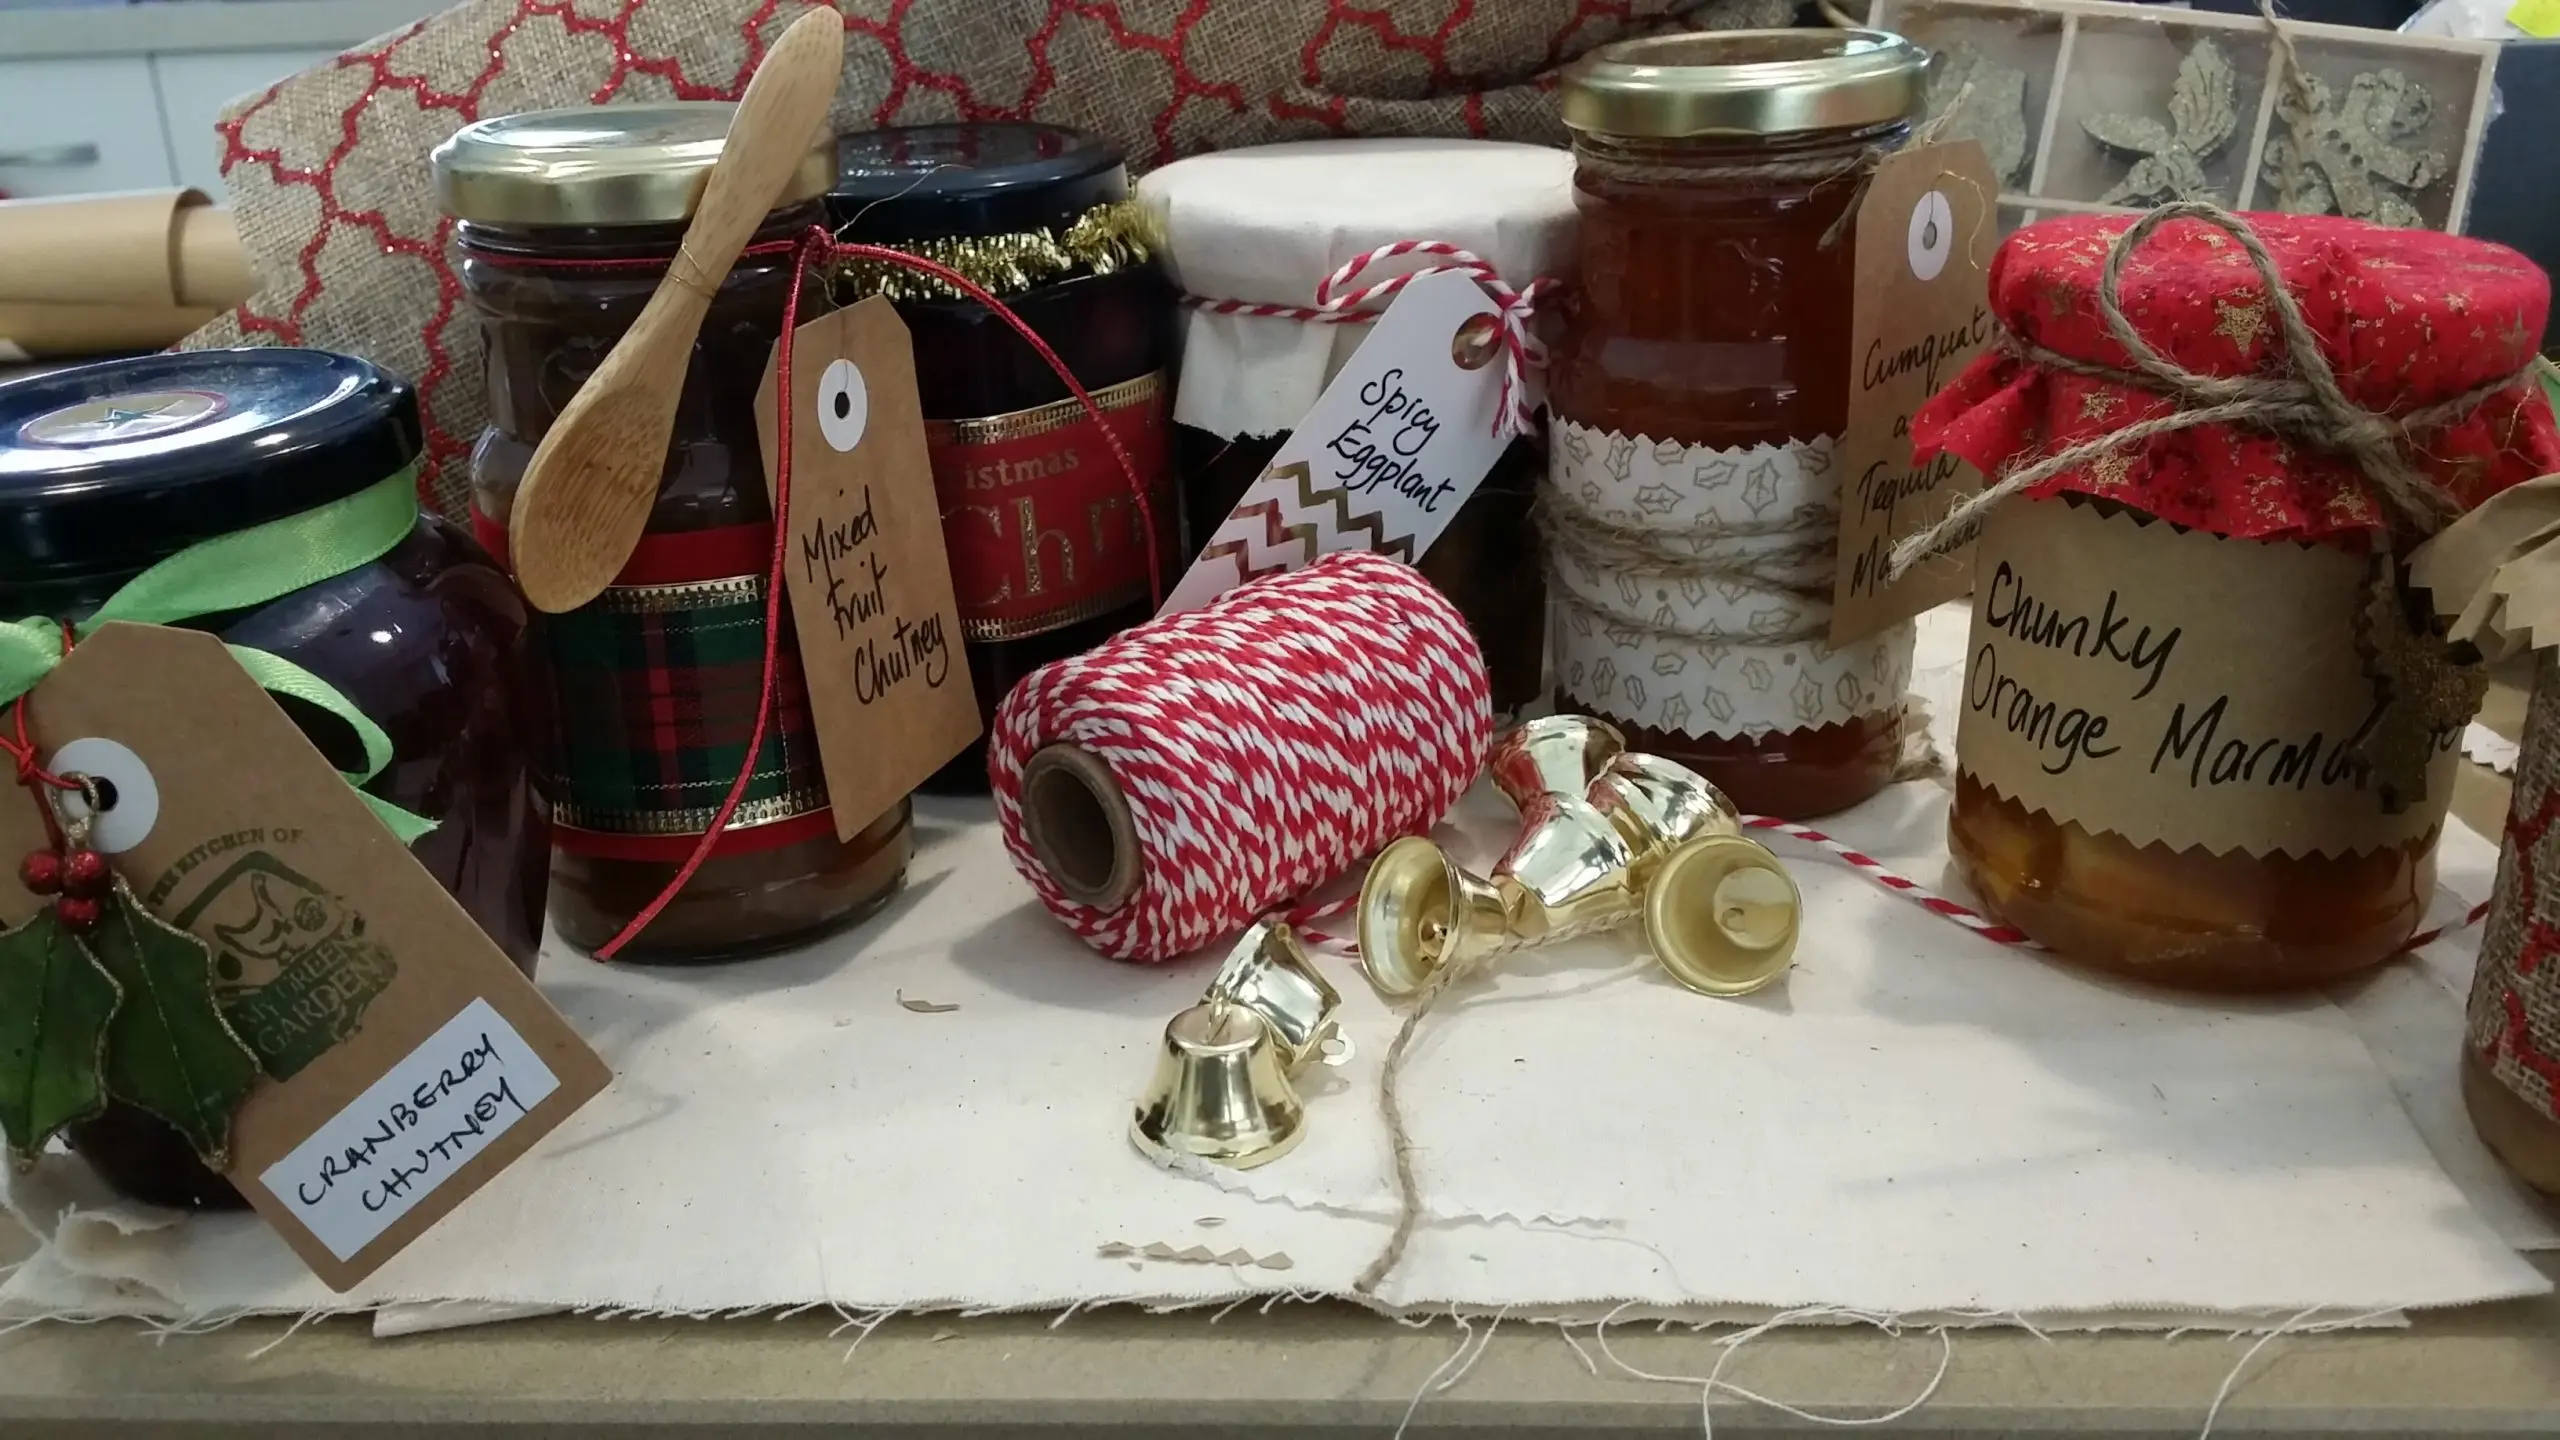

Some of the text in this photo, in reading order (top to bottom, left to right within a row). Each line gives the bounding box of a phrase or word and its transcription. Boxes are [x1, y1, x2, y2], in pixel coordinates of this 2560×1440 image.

[1360, 368, 1441, 456] Spicy
[1326, 418, 1456, 513] Eggplant
[802, 484, 878, 588] Mixed
[827, 551, 888, 641] Fruit
[1986, 559, 2182, 700] Chunky
[854, 612, 949, 705] Chutney
[1970, 643, 2122, 776] Orange
[175, 828, 265, 876] KITCHEN
[272, 828, 304, 843] OF
[257, 950, 378, 1055] GARDEN
[298, 1032, 505, 1206] CRANBERRY
[362, 1075, 529, 1212] CHUTNEY
